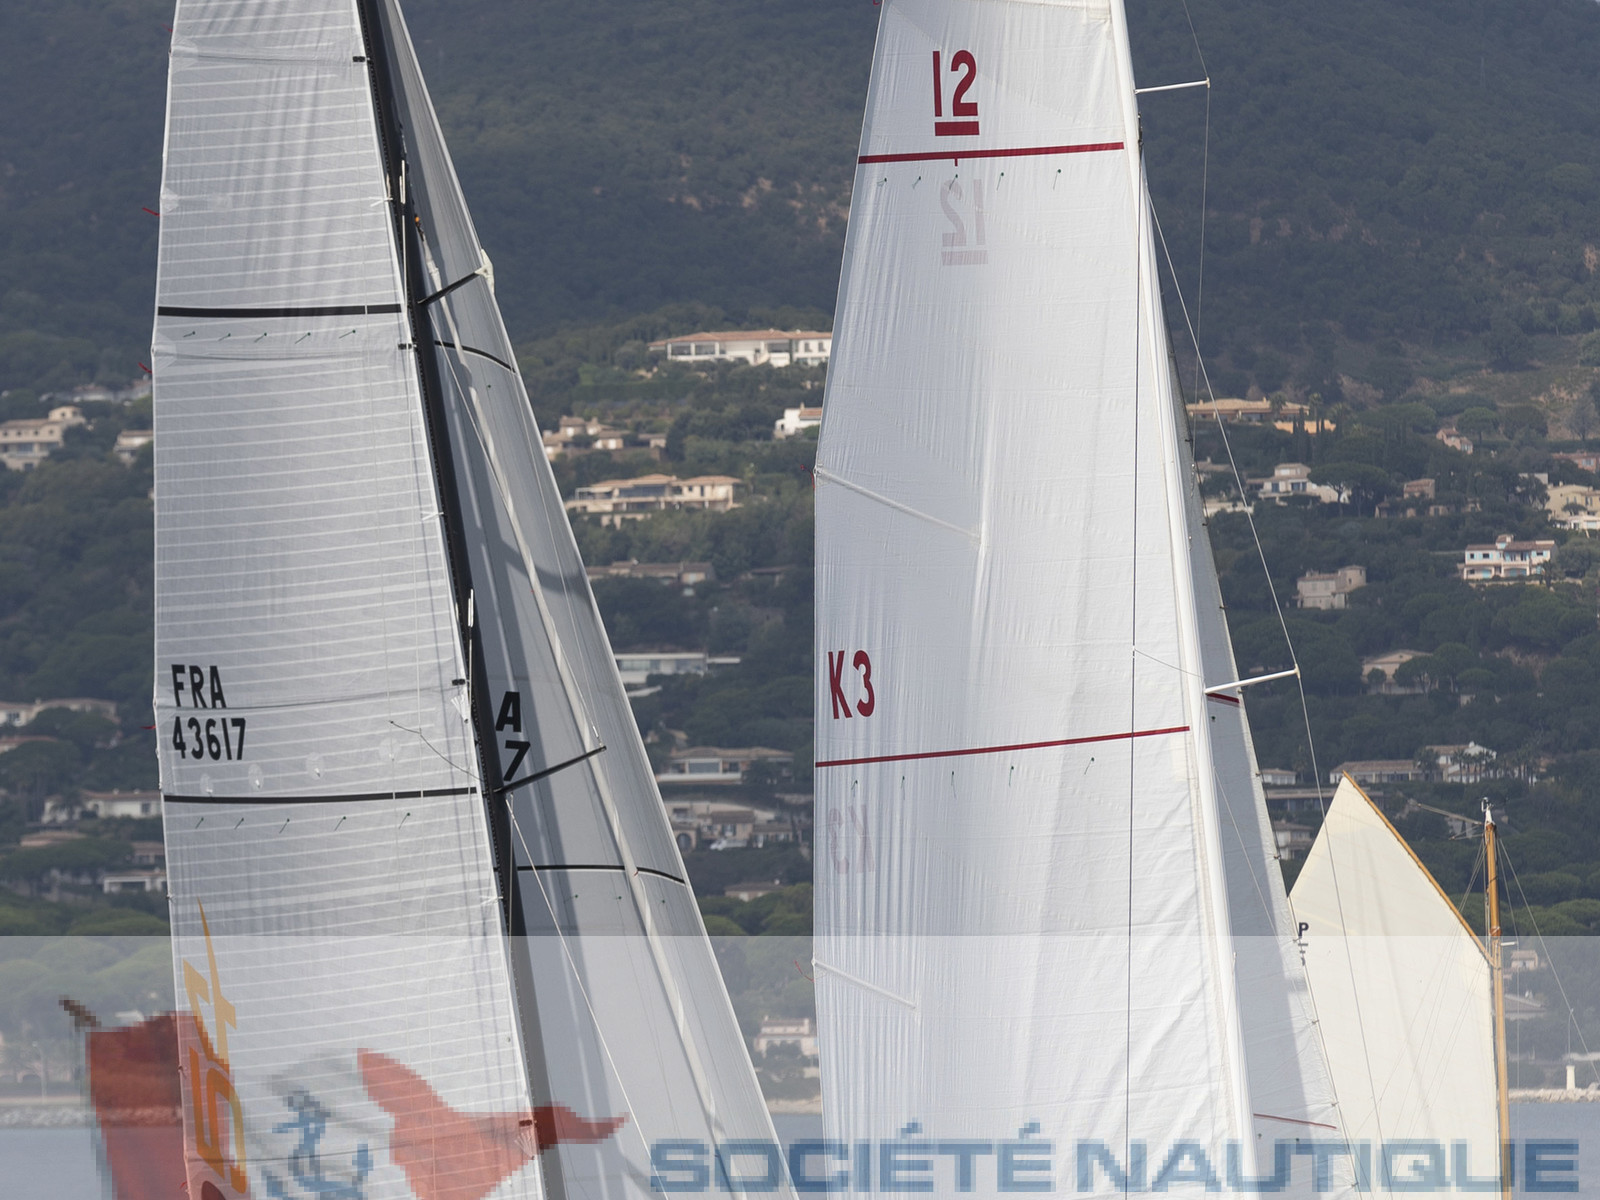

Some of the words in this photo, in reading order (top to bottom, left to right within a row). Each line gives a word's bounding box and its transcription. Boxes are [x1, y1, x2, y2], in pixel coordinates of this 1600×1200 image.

[933, 50, 978, 117] 12
[171, 664, 227, 708] FRA
[172, 716, 246, 761] 43617
